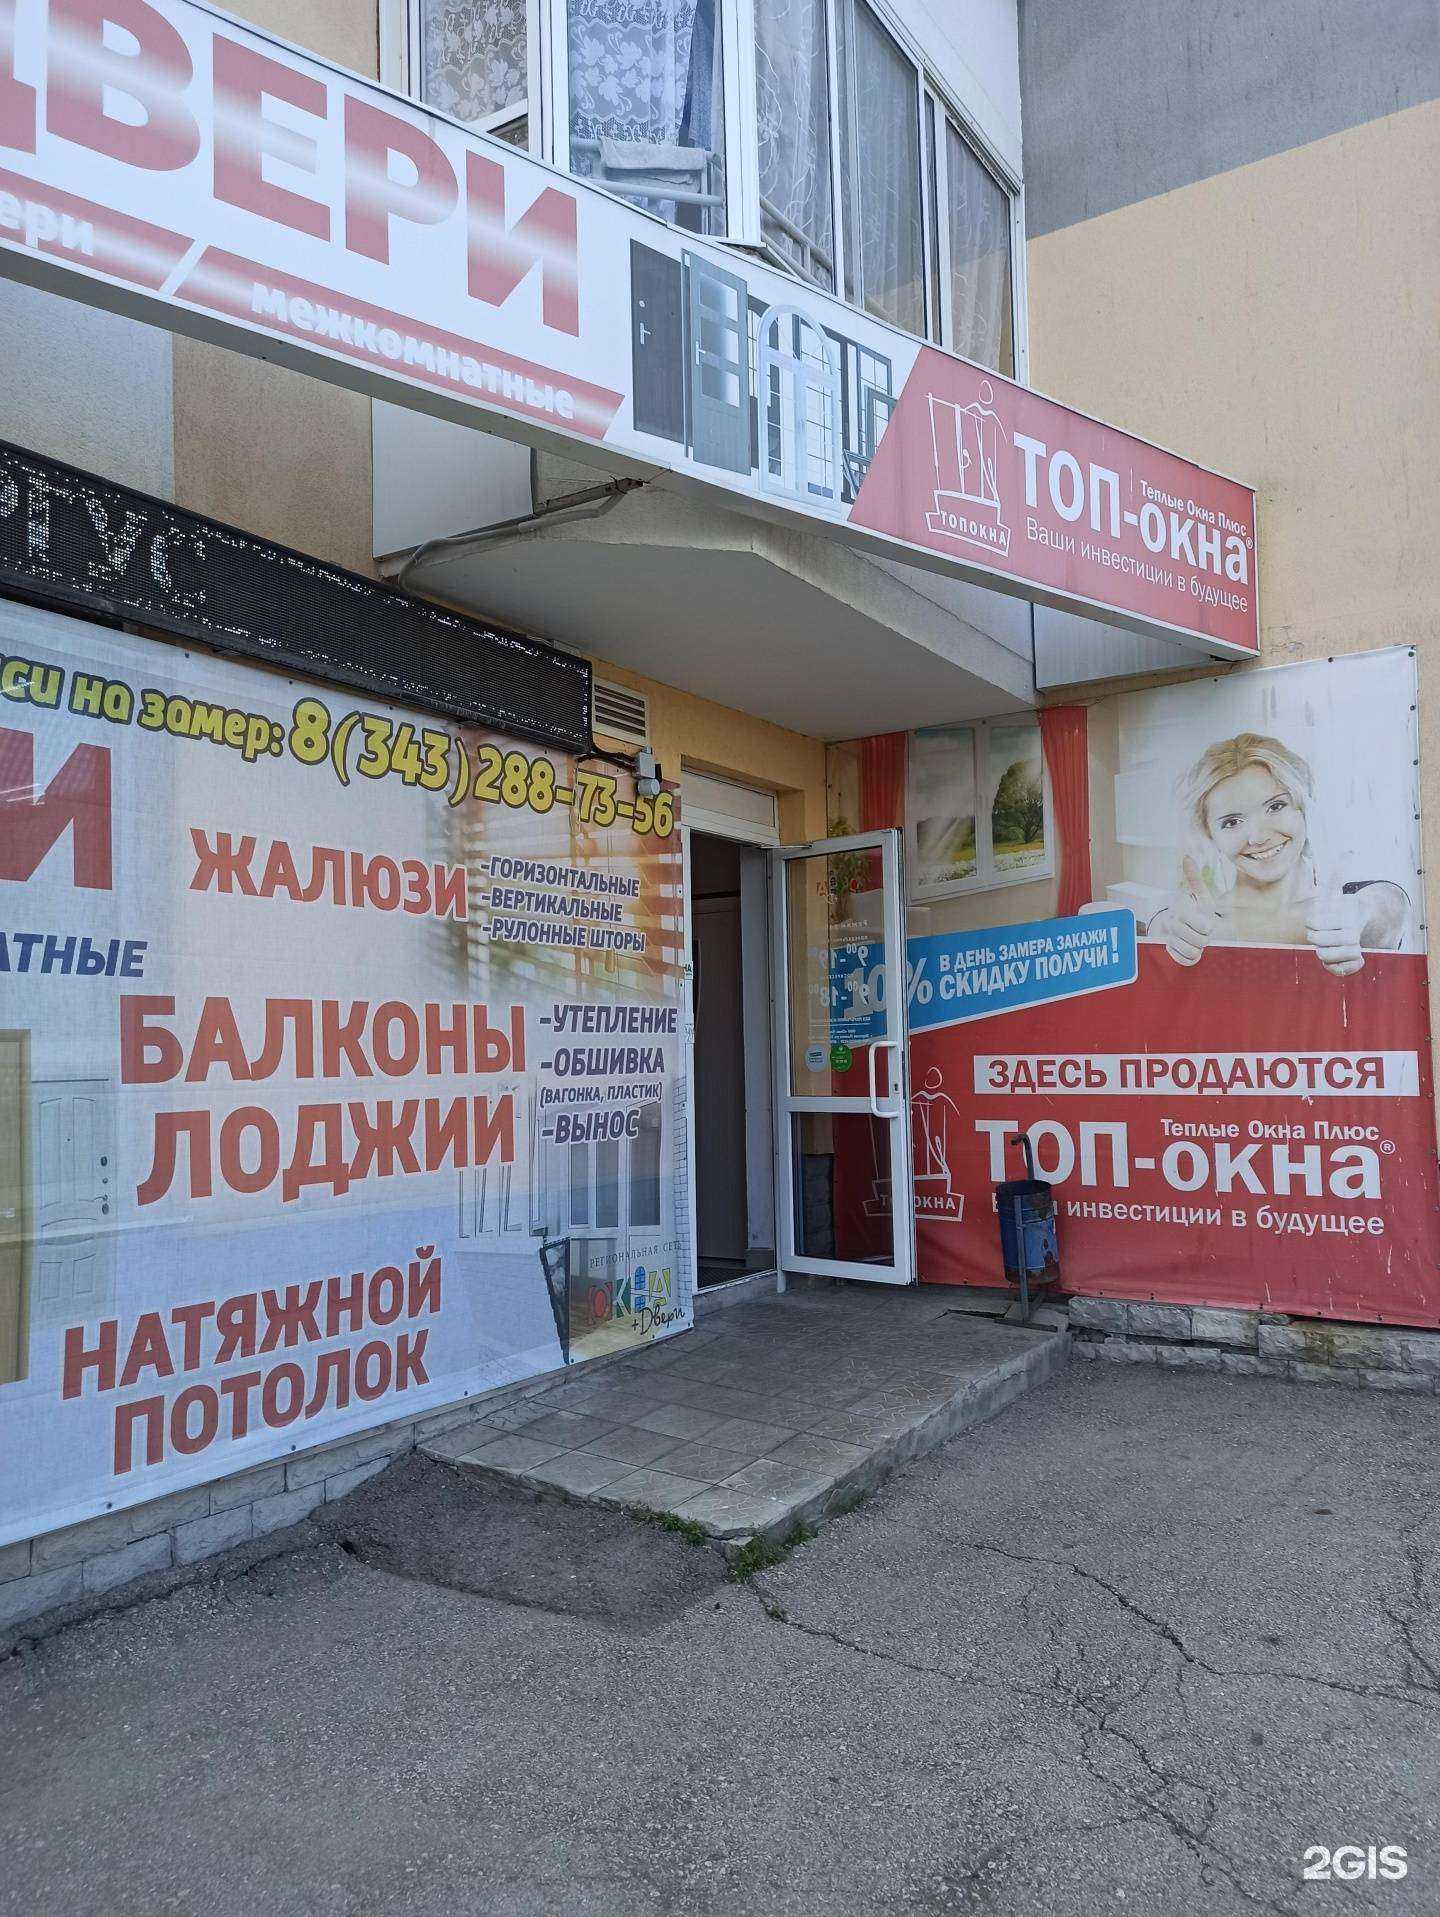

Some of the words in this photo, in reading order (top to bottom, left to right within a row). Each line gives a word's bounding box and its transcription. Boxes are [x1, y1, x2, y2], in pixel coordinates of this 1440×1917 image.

[251, 282, 574, 419] межкомнатные
[941, 511, 1006, 546] ТОПОКНА
[1141, 480, 1184, 511] Теплые
[1187, 500, 1215, 524] Окна
[1218, 512, 1247, 536] Плюс
[1026, 517, 1076, 555] Ваши
[1081, 541, 1173, 588] инвестиции
[1177, 575, 1186, 592] в
[1190, 576, 1248, 613] будущее
[0, 654, 65, 710] си
[69, 671, 135, 725] на
[137, 689, 285, 763] замер:
[189, 827, 469, 920] ЖАЛЮЗИ
[590, 929, 646, 951] ШТОРЫ
[939, 956, 950, 972] В
[954, 949, 996, 971] ДЕНЬ
[999, 939, 1053, 966] ЗАМЕРА
[1057, 929, 1107, 955] ЗАКАЖИ
[939, 961, 1028, 1000] СКИДКУ
[119, 994, 526, 1085] БАЛКОНЫ
[540, 1087, 604, 1108] (ВАГОНКА,
[607, 1082, 662, 1101] ПЛАСТИК)
[988, 1058, 1107, 1094] ЗДЕСЬ
[1119, 1057, 1385, 1094] ПРОДАЮТСЯ
[136, 1094, 516, 1206] ЛОДЖИИ
[1160, 1119, 1240, 1139] Теплые
[1248, 1120, 1306, 1140] Окна
[1314, 1121, 1380, 1141] Плюс
[1068, 1200, 1222, 1229] инвестиции
[1231, 1210, 1247, 1228] в
[1256, 1207, 1385, 1237] будущее
[590, 1246, 658, 1268] РЕГИОНАЛЬНАЯ
[62, 1244, 442, 1400] НАТЯЖНОЙ
[114, 1328, 430, 1475] ПОТОЛОК
